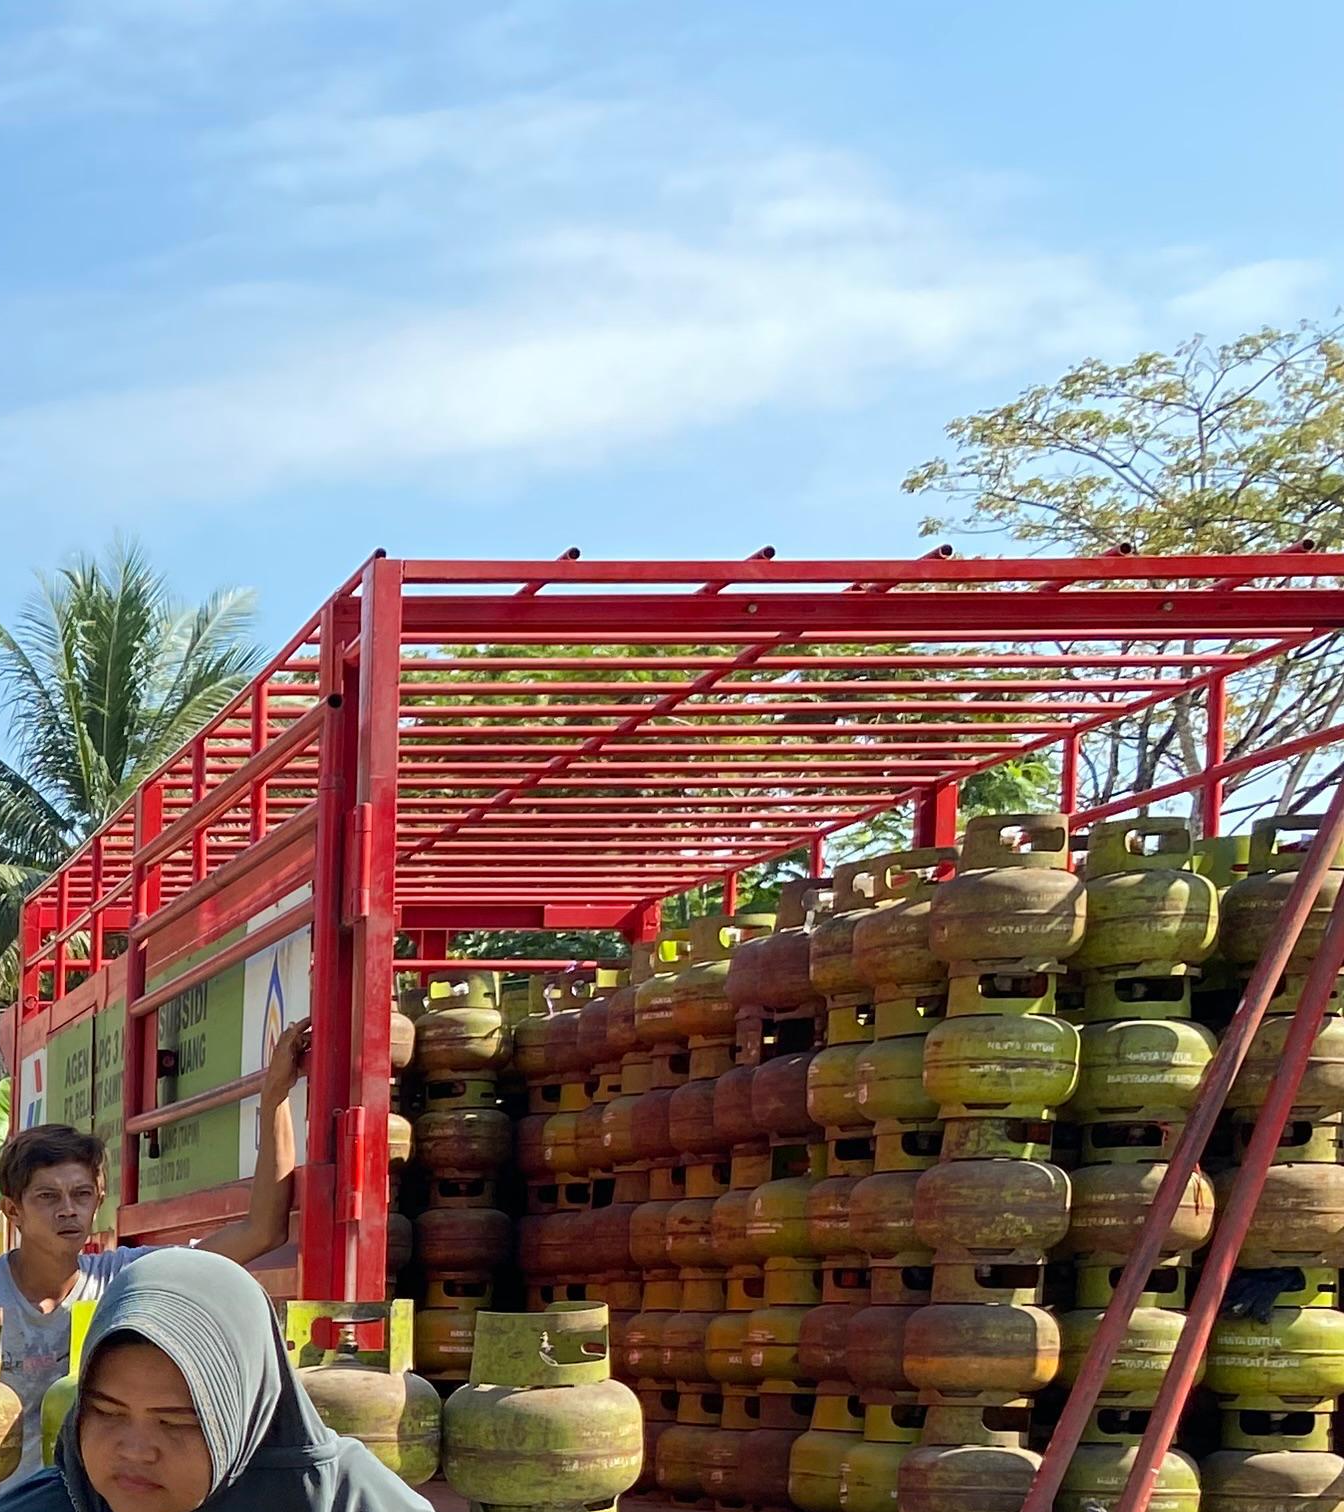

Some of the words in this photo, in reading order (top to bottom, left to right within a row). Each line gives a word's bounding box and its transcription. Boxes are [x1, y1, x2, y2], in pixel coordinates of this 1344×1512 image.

[65, 1047, 89, 1089] AGEN
[112, 1029, 120, 1065] 3
[179, 1032, 207, 1077] UANG
